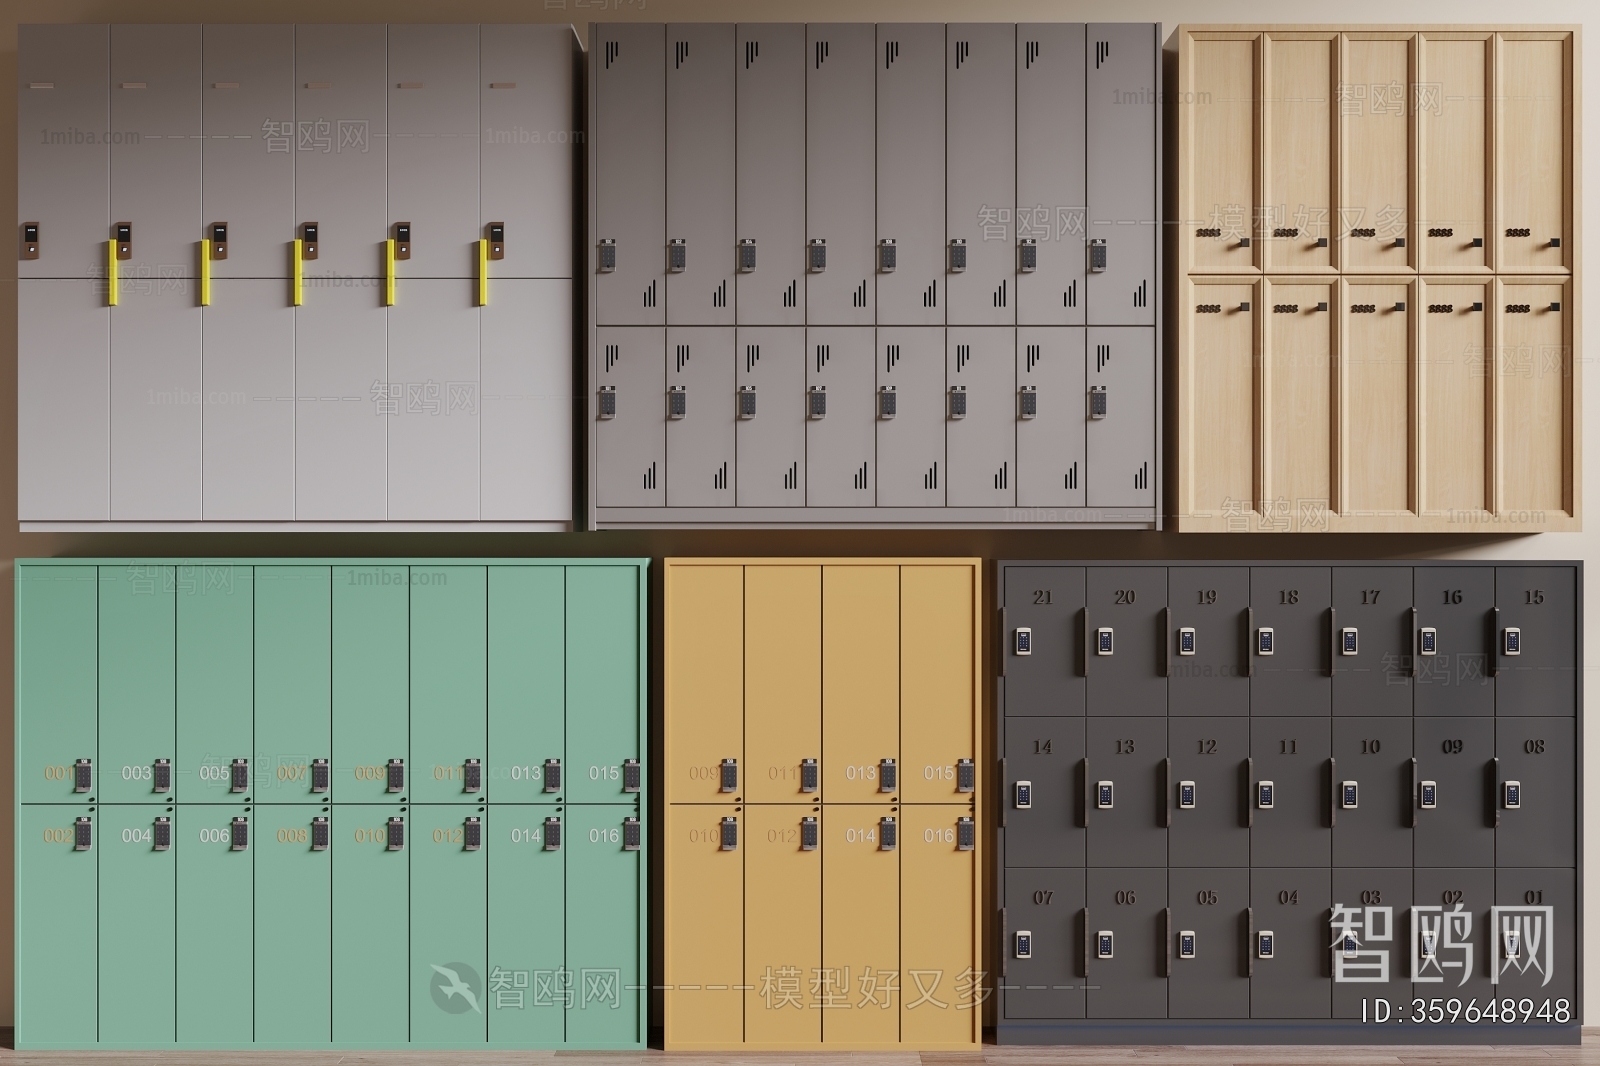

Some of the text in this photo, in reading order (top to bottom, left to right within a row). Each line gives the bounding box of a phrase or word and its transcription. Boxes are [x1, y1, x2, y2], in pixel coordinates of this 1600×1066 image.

[1033, 589, 1054, 605] 21
[1115, 589, 1137, 605] 20
[1197, 589, 1218, 605] 19
[1279, 589, 1300, 605] 18
[1361, 589, 1381, 605] 17
[1443, 589, 1463, 605] 16
[1525, 589, 1545, 605] 15
[1033, 739, 1053, 754] 14
[1115, 739, 1136, 754] 13
[1197, 739, 1218, 754] 12
[1279, 739, 1298, 754] 11
[1361, 739, 1381, 754] 10
[1442, 739, 1463, 754] 09
[1524, 739, 1545, 754] 08
[44, 766, 75, 781] 001
[122, 766, 152, 781] 003
[199, 766, 230, 781] 005
[277, 766, 307, 781] 007
[355, 766, 385, 781] 009
[511, 766, 541, 781] 013
[589, 766, 619, 781] 015
[689, 766, 719, 781] 009
[846, 766, 876, 781] 013
[923, 766, 954, 781] 015
[43, 828, 74, 843] 002
[122, 828, 152, 843] 004
[199, 828, 230, 843] 006
[277, 828, 308, 843] 008
[355, 828, 386, 843] 010
[433, 828, 464, 843] 012
[511, 828, 541, 843] 014
[589, 828, 619, 843] 016
[689, 828, 719, 843] 010
[767, 828, 797, 843] 012
[845, 828, 876, 843] 014
[923, 828, 954, 843] 016
[1033, 890, 1055, 905] 07
[1115, 890, 1137, 905] 06
[1197, 890, 1219, 905] 05
[1279, 890, 1300, 905] 04
[1362, 890, 1382, 905] 03
[1443, 890, 1464, 905] 02
[1524, 890, 1543, 905] 01
